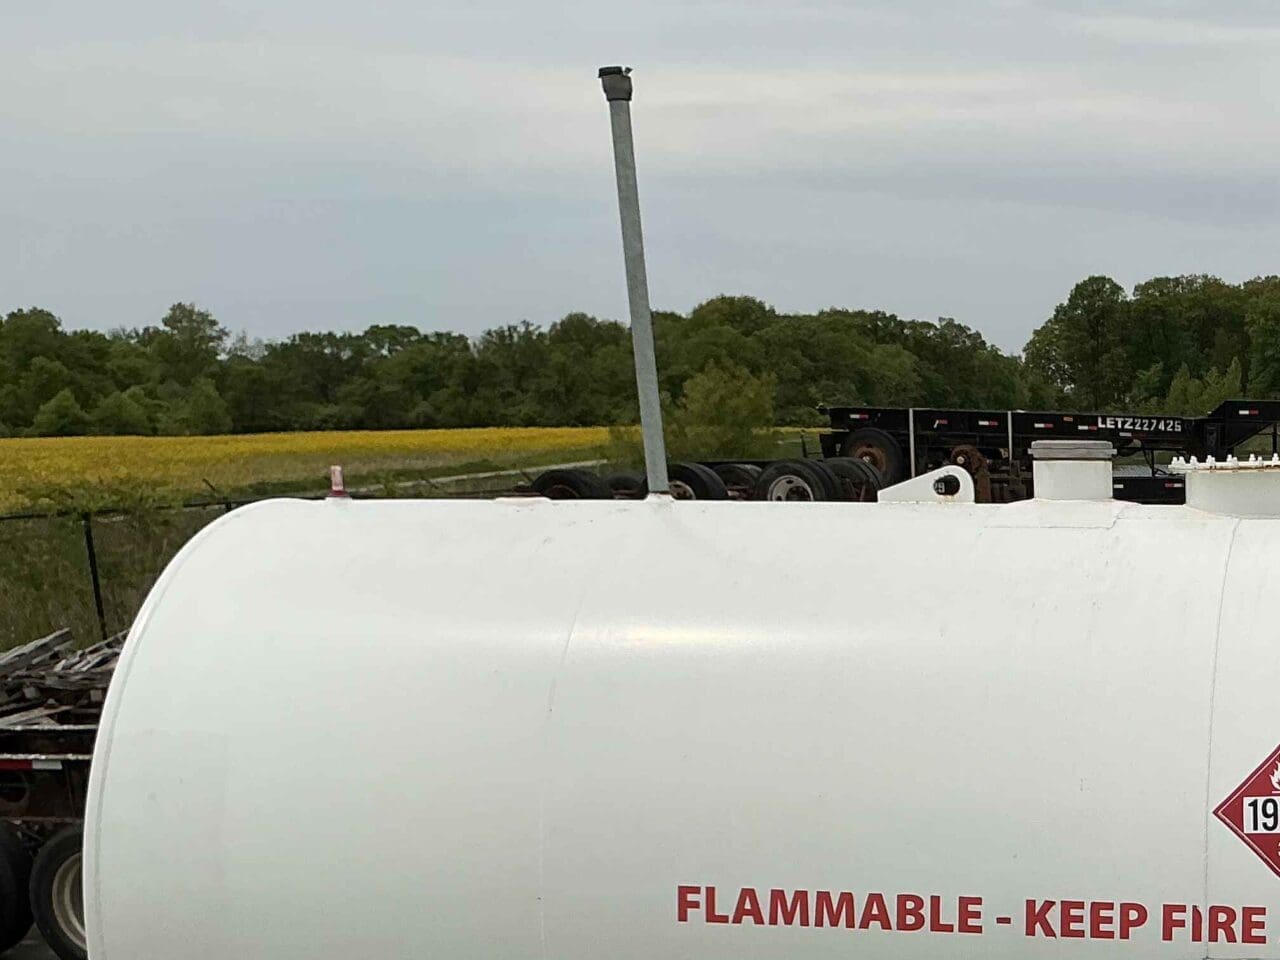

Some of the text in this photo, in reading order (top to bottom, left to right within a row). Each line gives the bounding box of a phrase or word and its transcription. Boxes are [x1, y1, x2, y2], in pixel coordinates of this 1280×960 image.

[678, 886, 983, 934] FLAMMABLE
[1026, 899, 1148, 940] KEEP
[1162, 904, 1267, 945] FIRE
